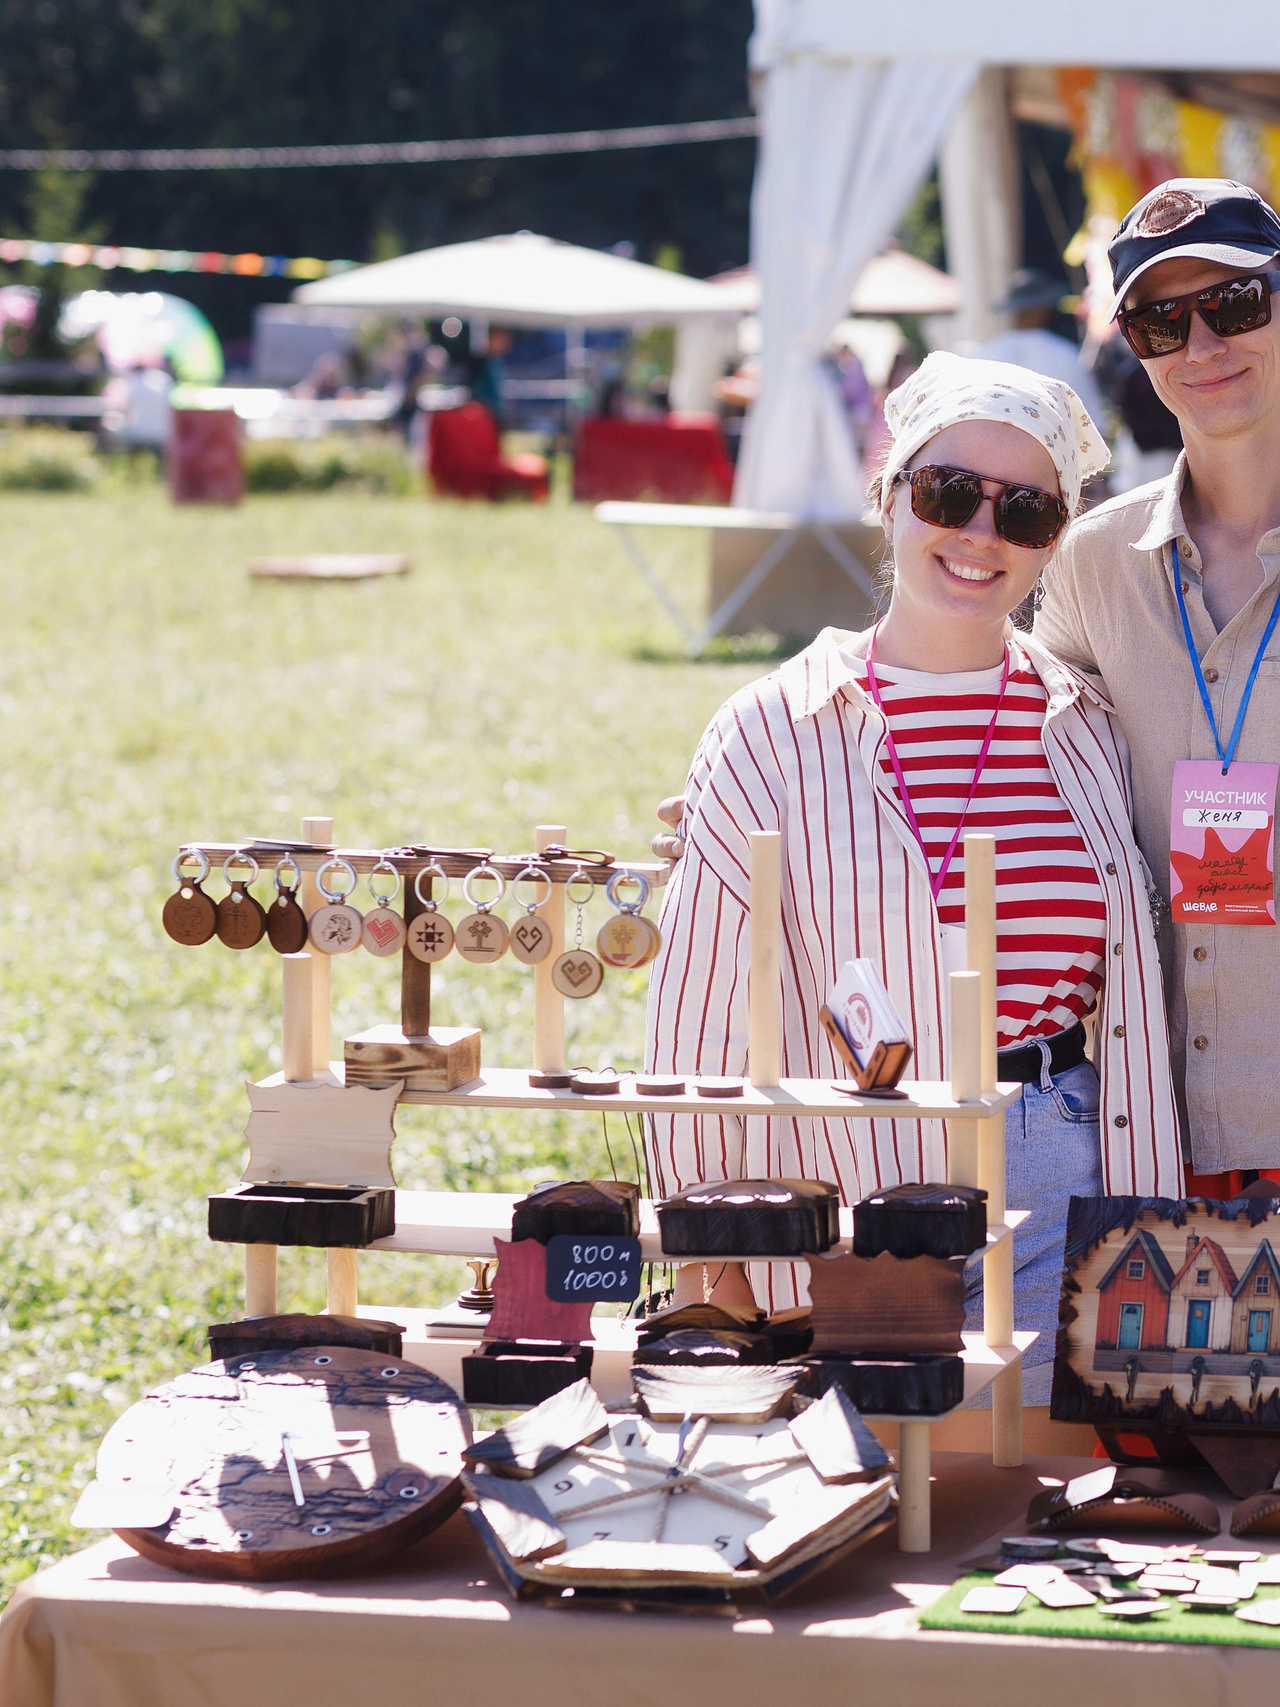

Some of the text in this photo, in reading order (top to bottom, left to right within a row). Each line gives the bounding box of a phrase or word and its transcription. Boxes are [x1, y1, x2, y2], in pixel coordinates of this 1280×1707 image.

[1184, 789, 1267, 805] УЧАСТНИК
[1198, 809, 1243, 823] Женя
[572, 1244, 615, 1264] 800
[563, 1269, 617, 1290] 1000
[714, 1535, 732, 1551] 5
